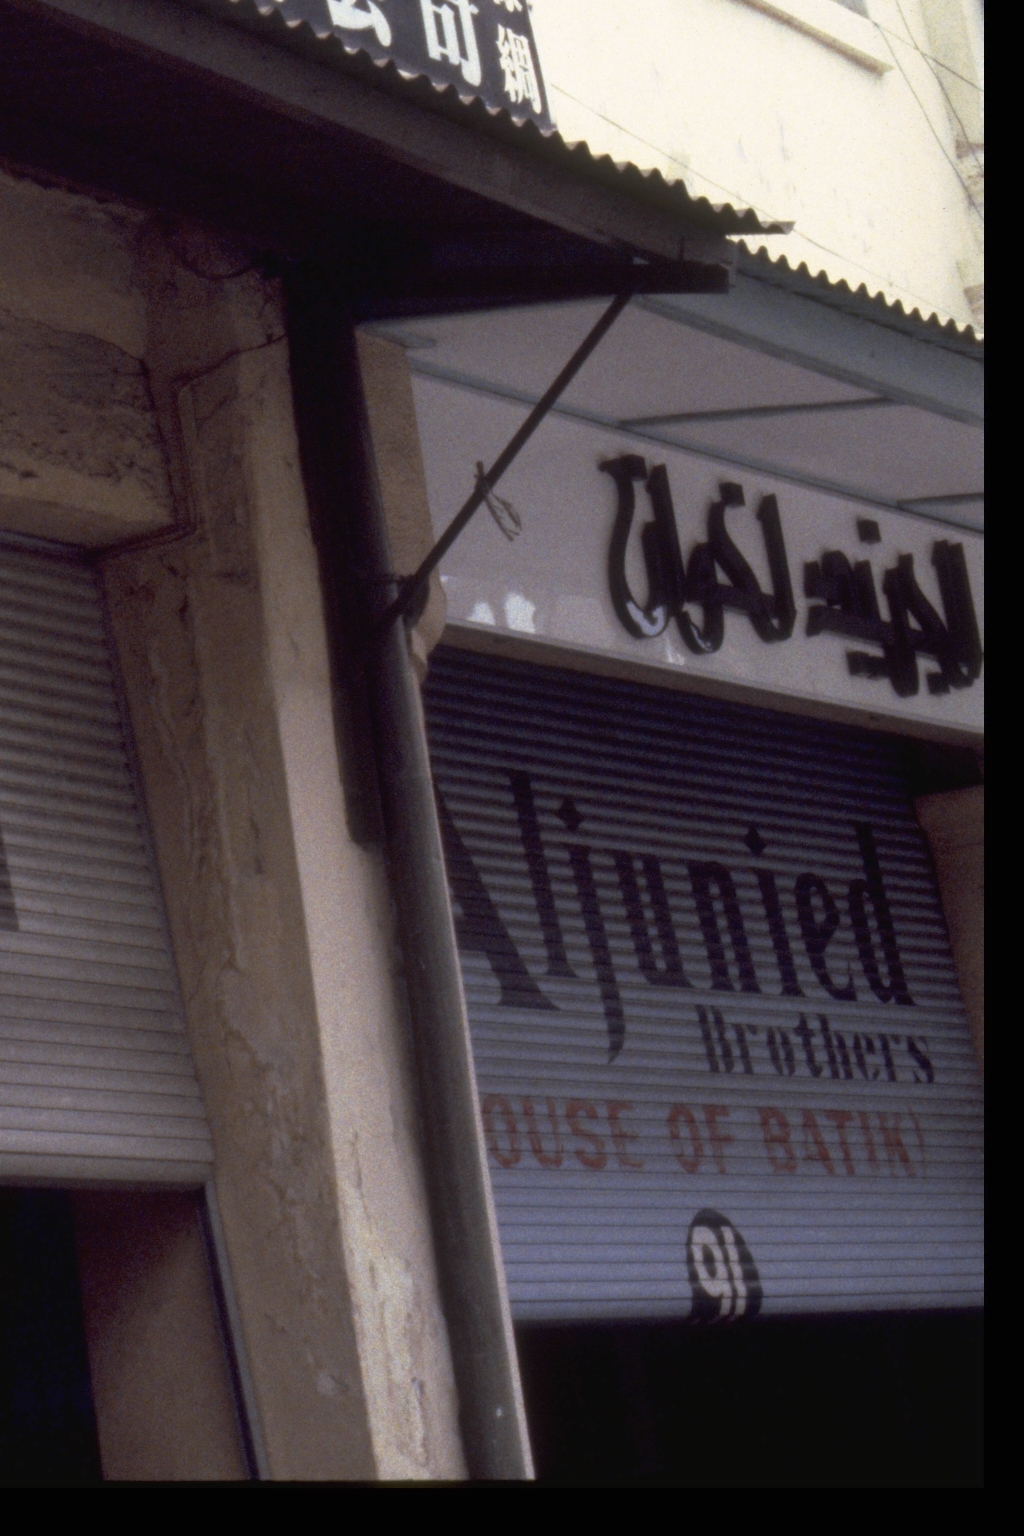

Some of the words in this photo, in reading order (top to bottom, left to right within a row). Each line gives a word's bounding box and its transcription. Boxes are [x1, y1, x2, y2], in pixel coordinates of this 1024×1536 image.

[696, 1003, 935, 1084] Brothers
[667, 1103, 734, 1174] OF
[690, 1225, 747, 1317] 91
